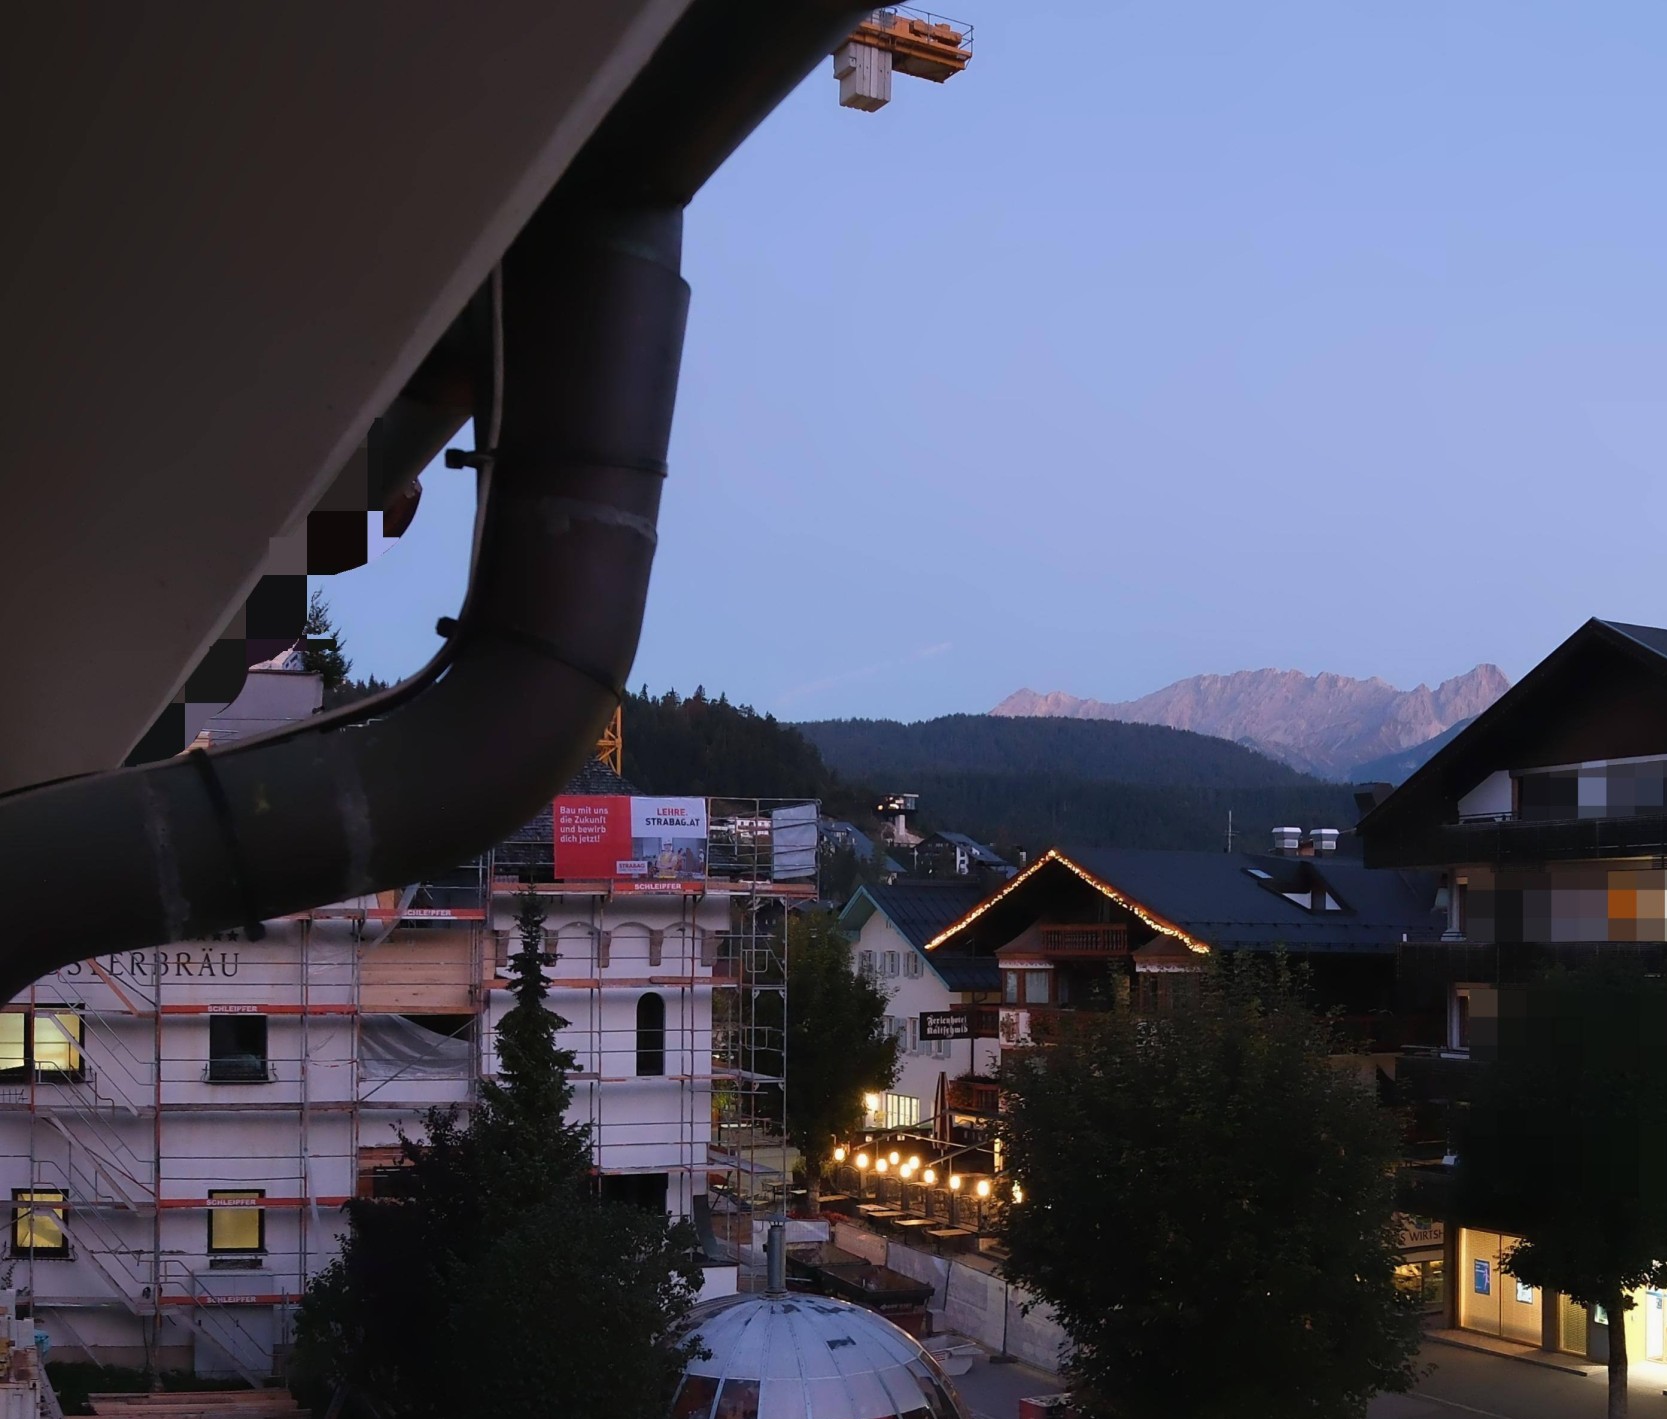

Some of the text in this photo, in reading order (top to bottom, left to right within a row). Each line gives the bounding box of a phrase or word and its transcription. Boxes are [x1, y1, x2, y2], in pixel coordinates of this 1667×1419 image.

[560, 806, 609, 815] Bau mit uns
[657, 808, 688, 816] LEHRE.
[560, 816, 606, 824] die Zukunft
[645, 818, 700, 827] STRABAG.AT
[560, 825, 607, 834] und bewirb
[560, 835, 601, 845] dich jetzt!
